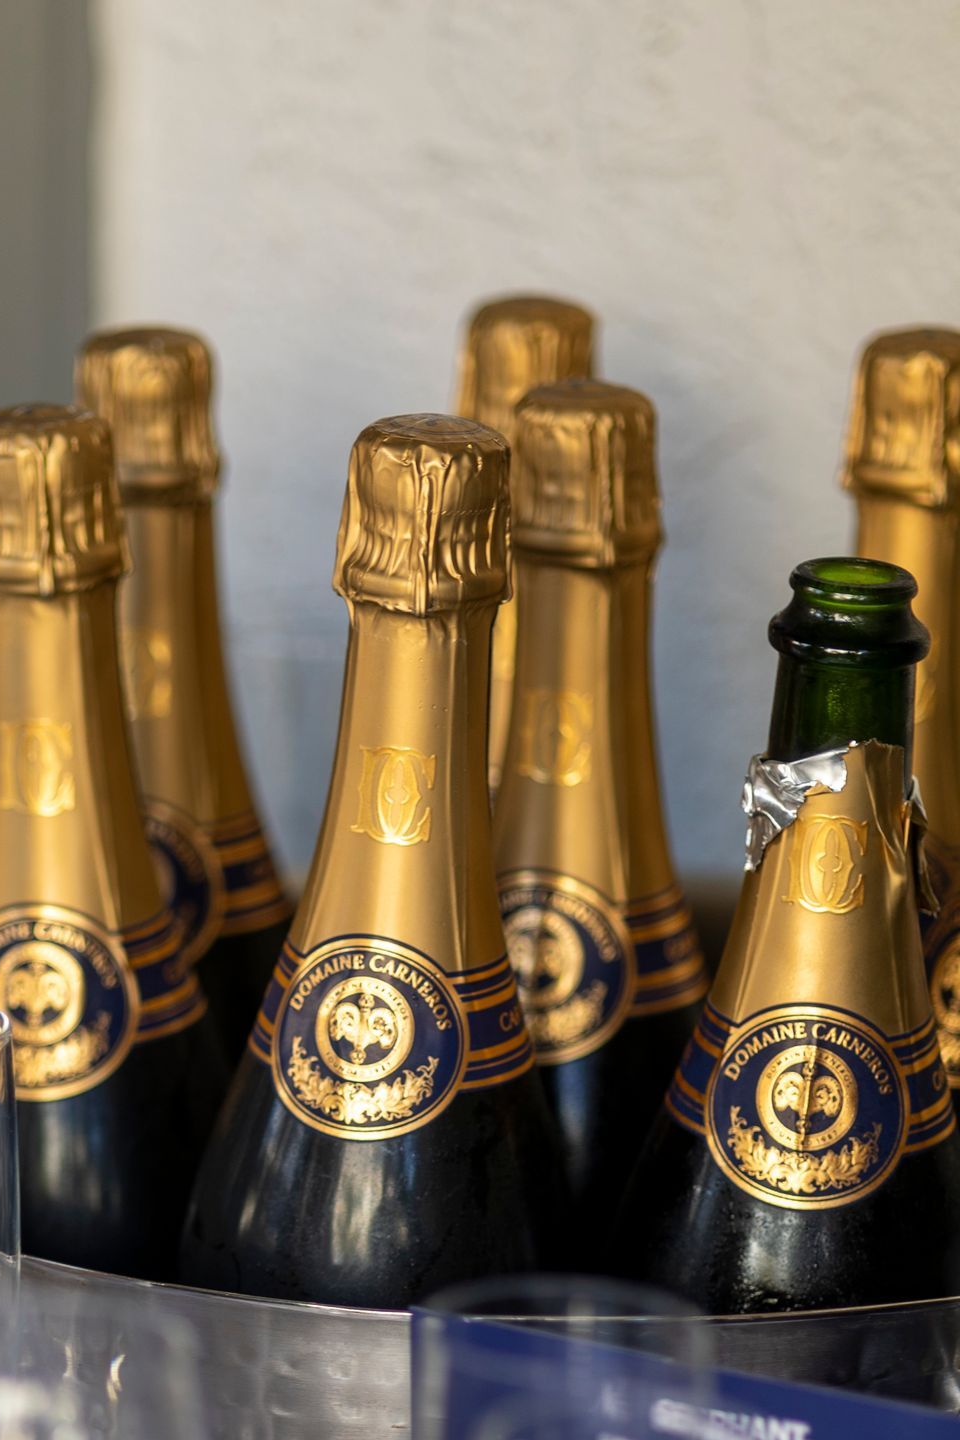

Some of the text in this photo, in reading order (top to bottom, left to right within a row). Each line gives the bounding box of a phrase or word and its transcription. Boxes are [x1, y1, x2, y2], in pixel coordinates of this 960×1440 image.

[290, 953, 452, 1032] DOMAINE CARNEROS
[723, 1021, 893, 1096] DOMAINE CARNEROS
